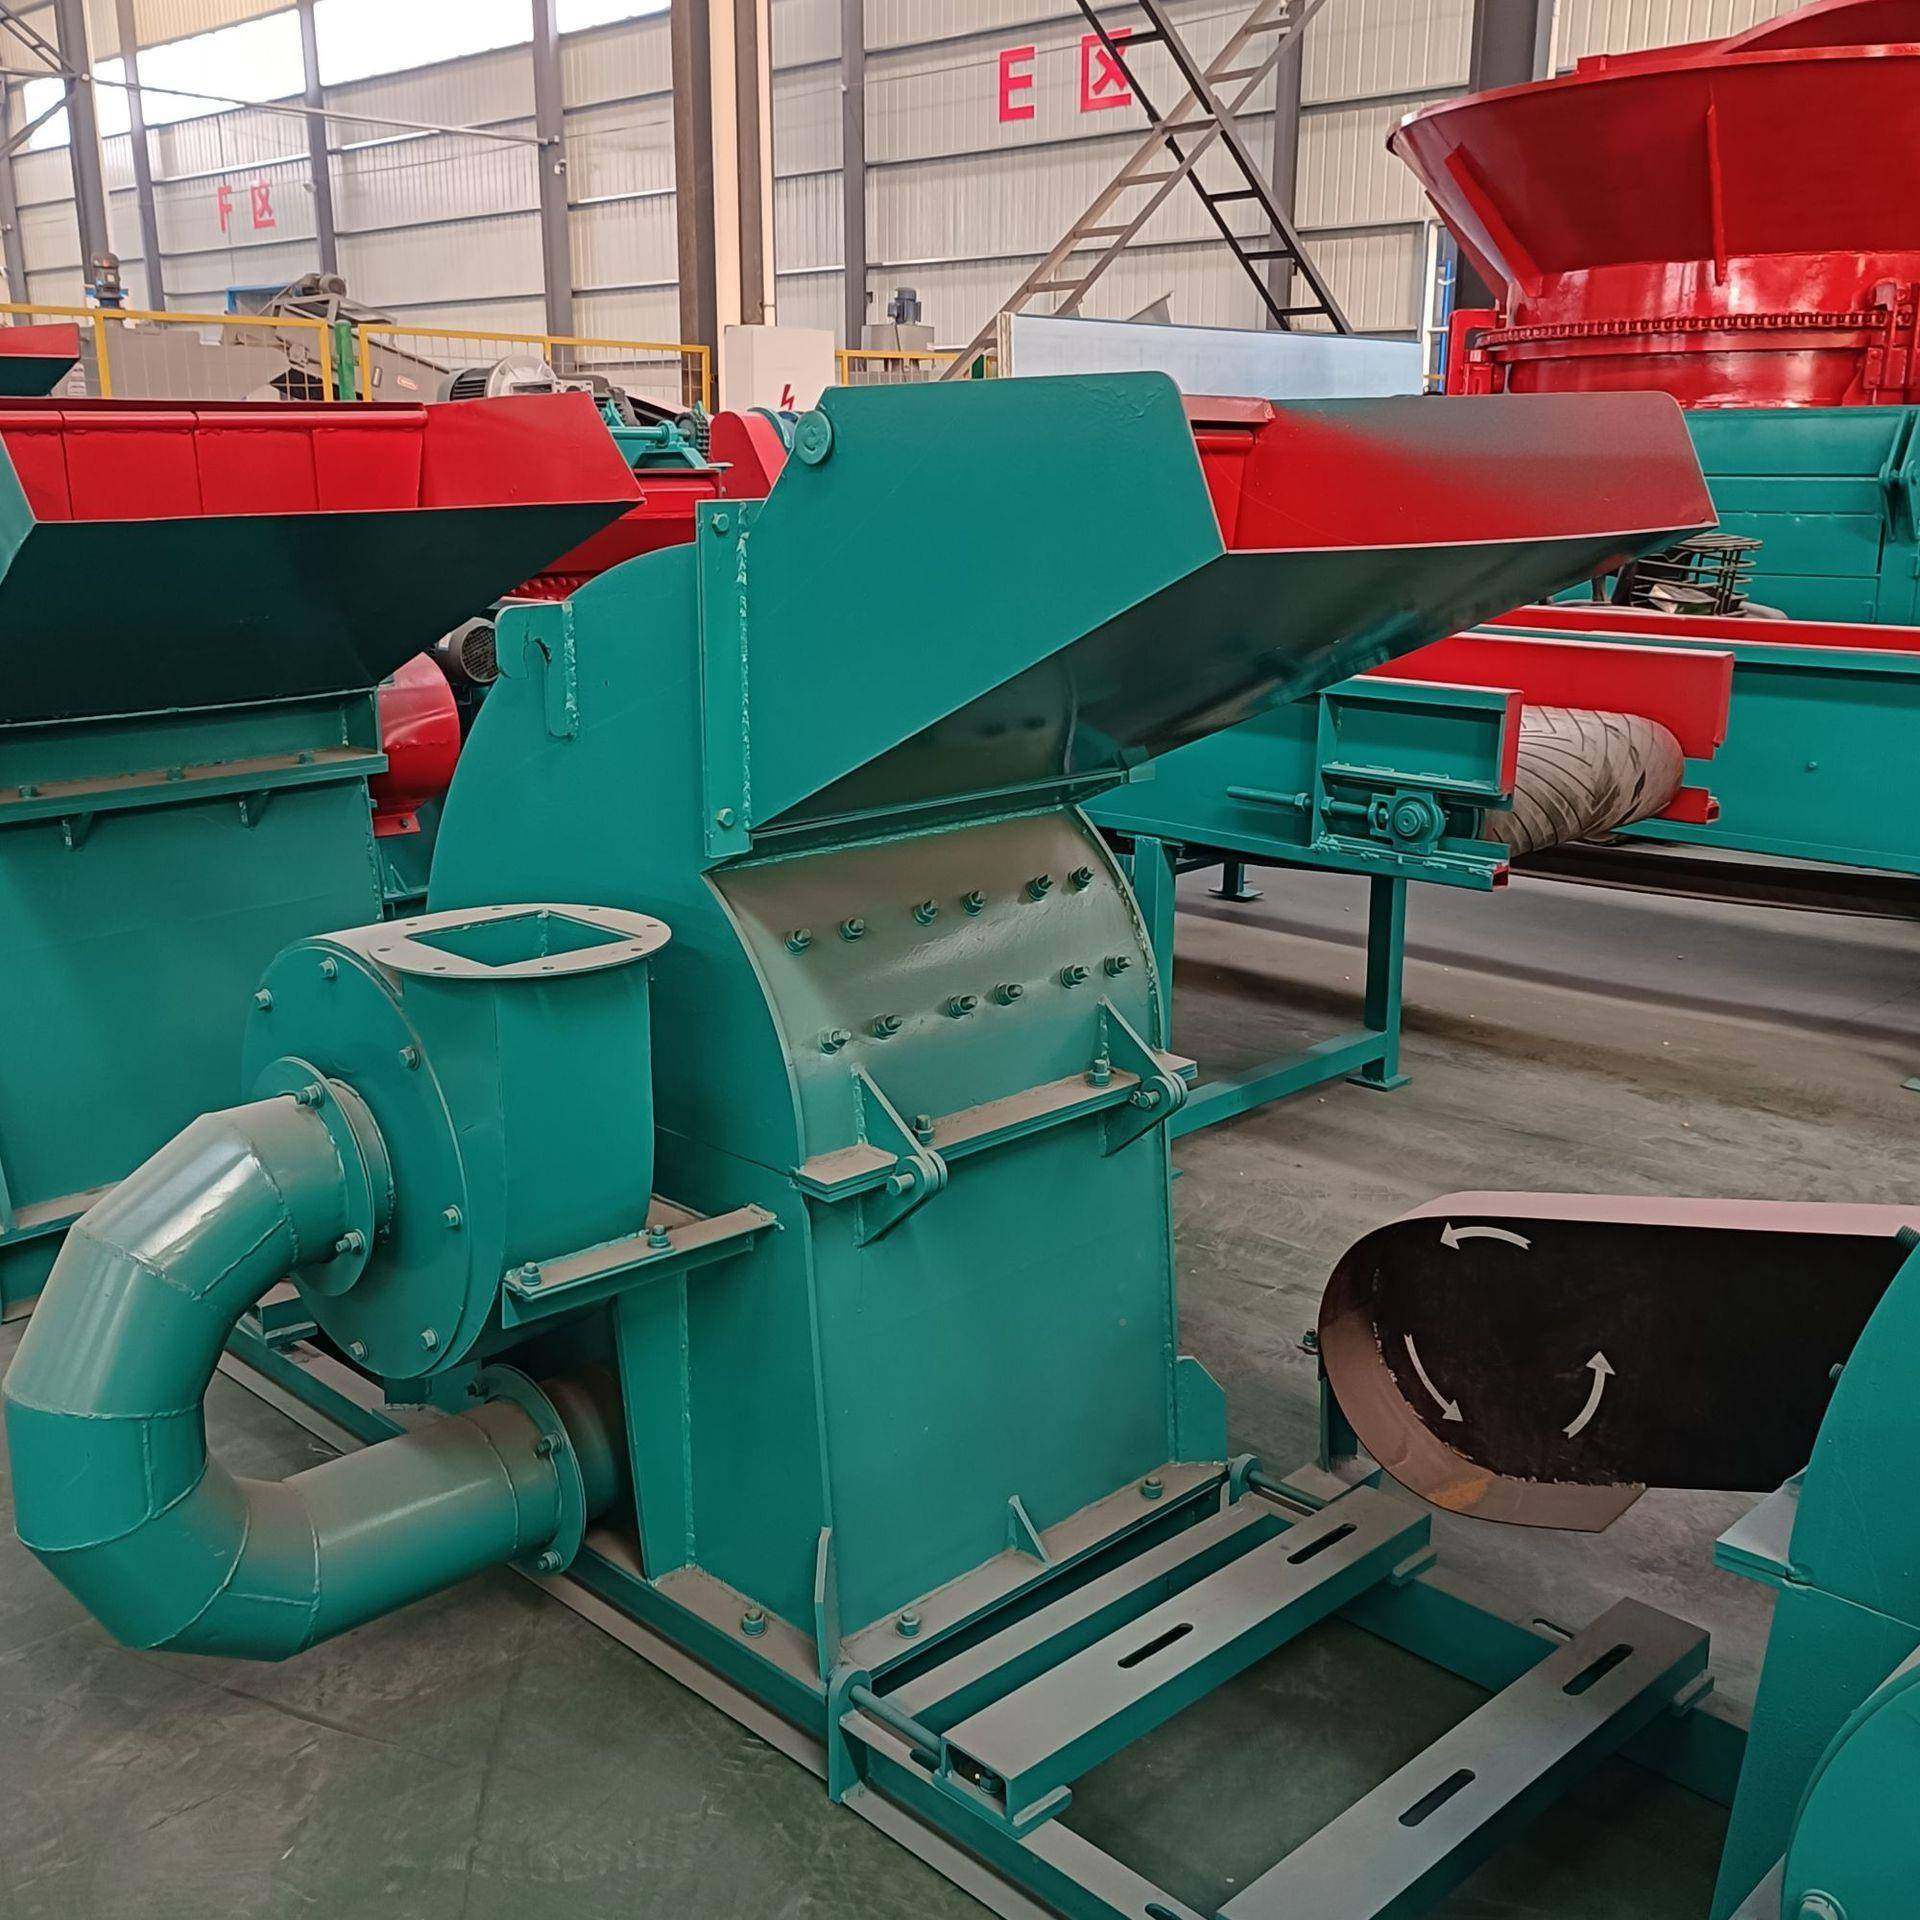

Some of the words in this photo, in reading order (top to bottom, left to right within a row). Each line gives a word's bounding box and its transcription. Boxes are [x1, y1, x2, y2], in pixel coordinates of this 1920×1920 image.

[999, 46, 1035, 122] E
[1080, 28, 1132, 113] 区
[218, 185, 233, 234] F
[251, 181, 276, 229] 区
